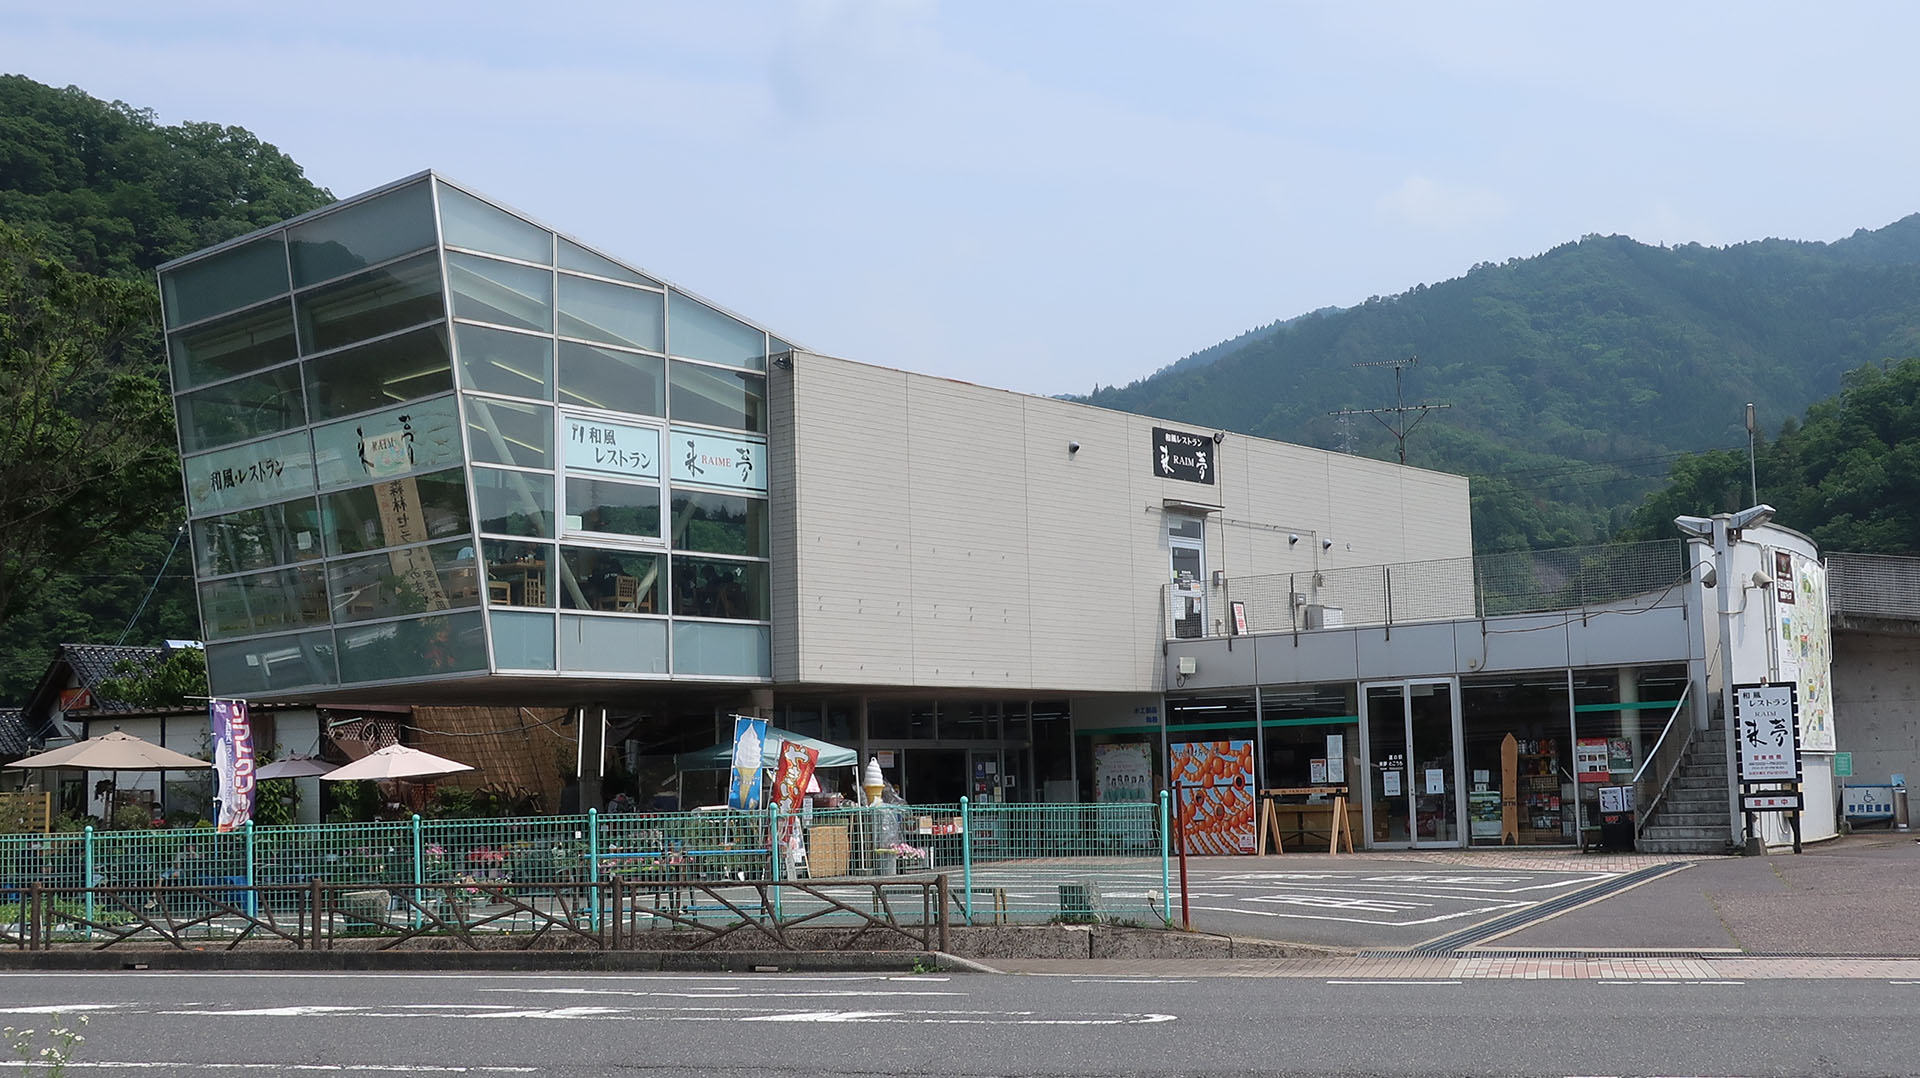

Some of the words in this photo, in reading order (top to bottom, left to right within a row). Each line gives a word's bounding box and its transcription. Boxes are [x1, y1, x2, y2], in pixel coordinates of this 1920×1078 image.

[589, 427, 616, 446] 和風
[1165, 432, 1204, 447] 和風レストラン
[595, 446, 652, 470] レストラン
[684, 440, 704, 477] 来
[701, 454, 731, 467] RAIME
[735, 447, 753, 482] 夢
[1173, 454, 1195, 468] RAIM
[1749, 698, 1789, 707] レストラン
[1754, 799, 1789, 807] 営業中
